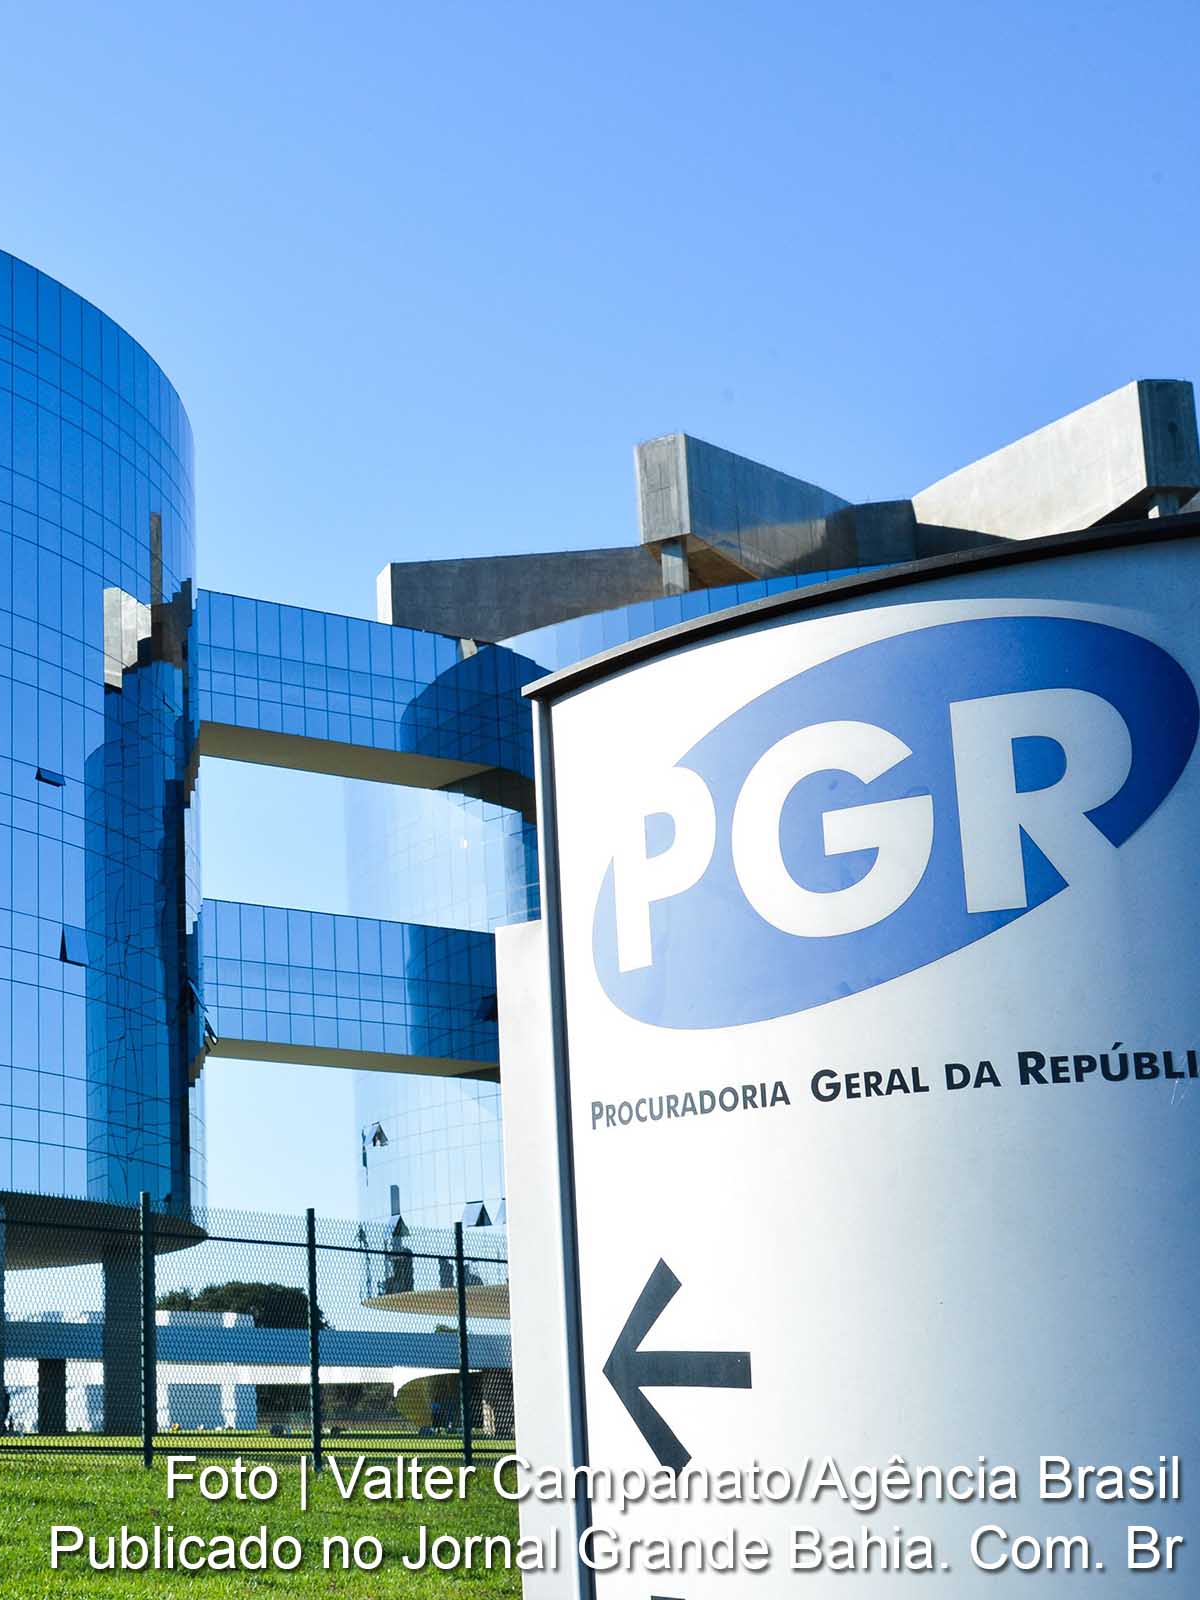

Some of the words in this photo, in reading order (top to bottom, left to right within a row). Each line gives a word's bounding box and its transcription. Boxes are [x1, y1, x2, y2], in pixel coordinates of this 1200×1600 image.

[611, 687, 1133, 974] PGR
[591, 1080, 791, 1131] PROCURADORIA
[810, 1068, 930, 1103] GERAL
[944, 1060, 1002, 1091] DA
[1016, 1041, 1200, 1086] REPÚBLI
